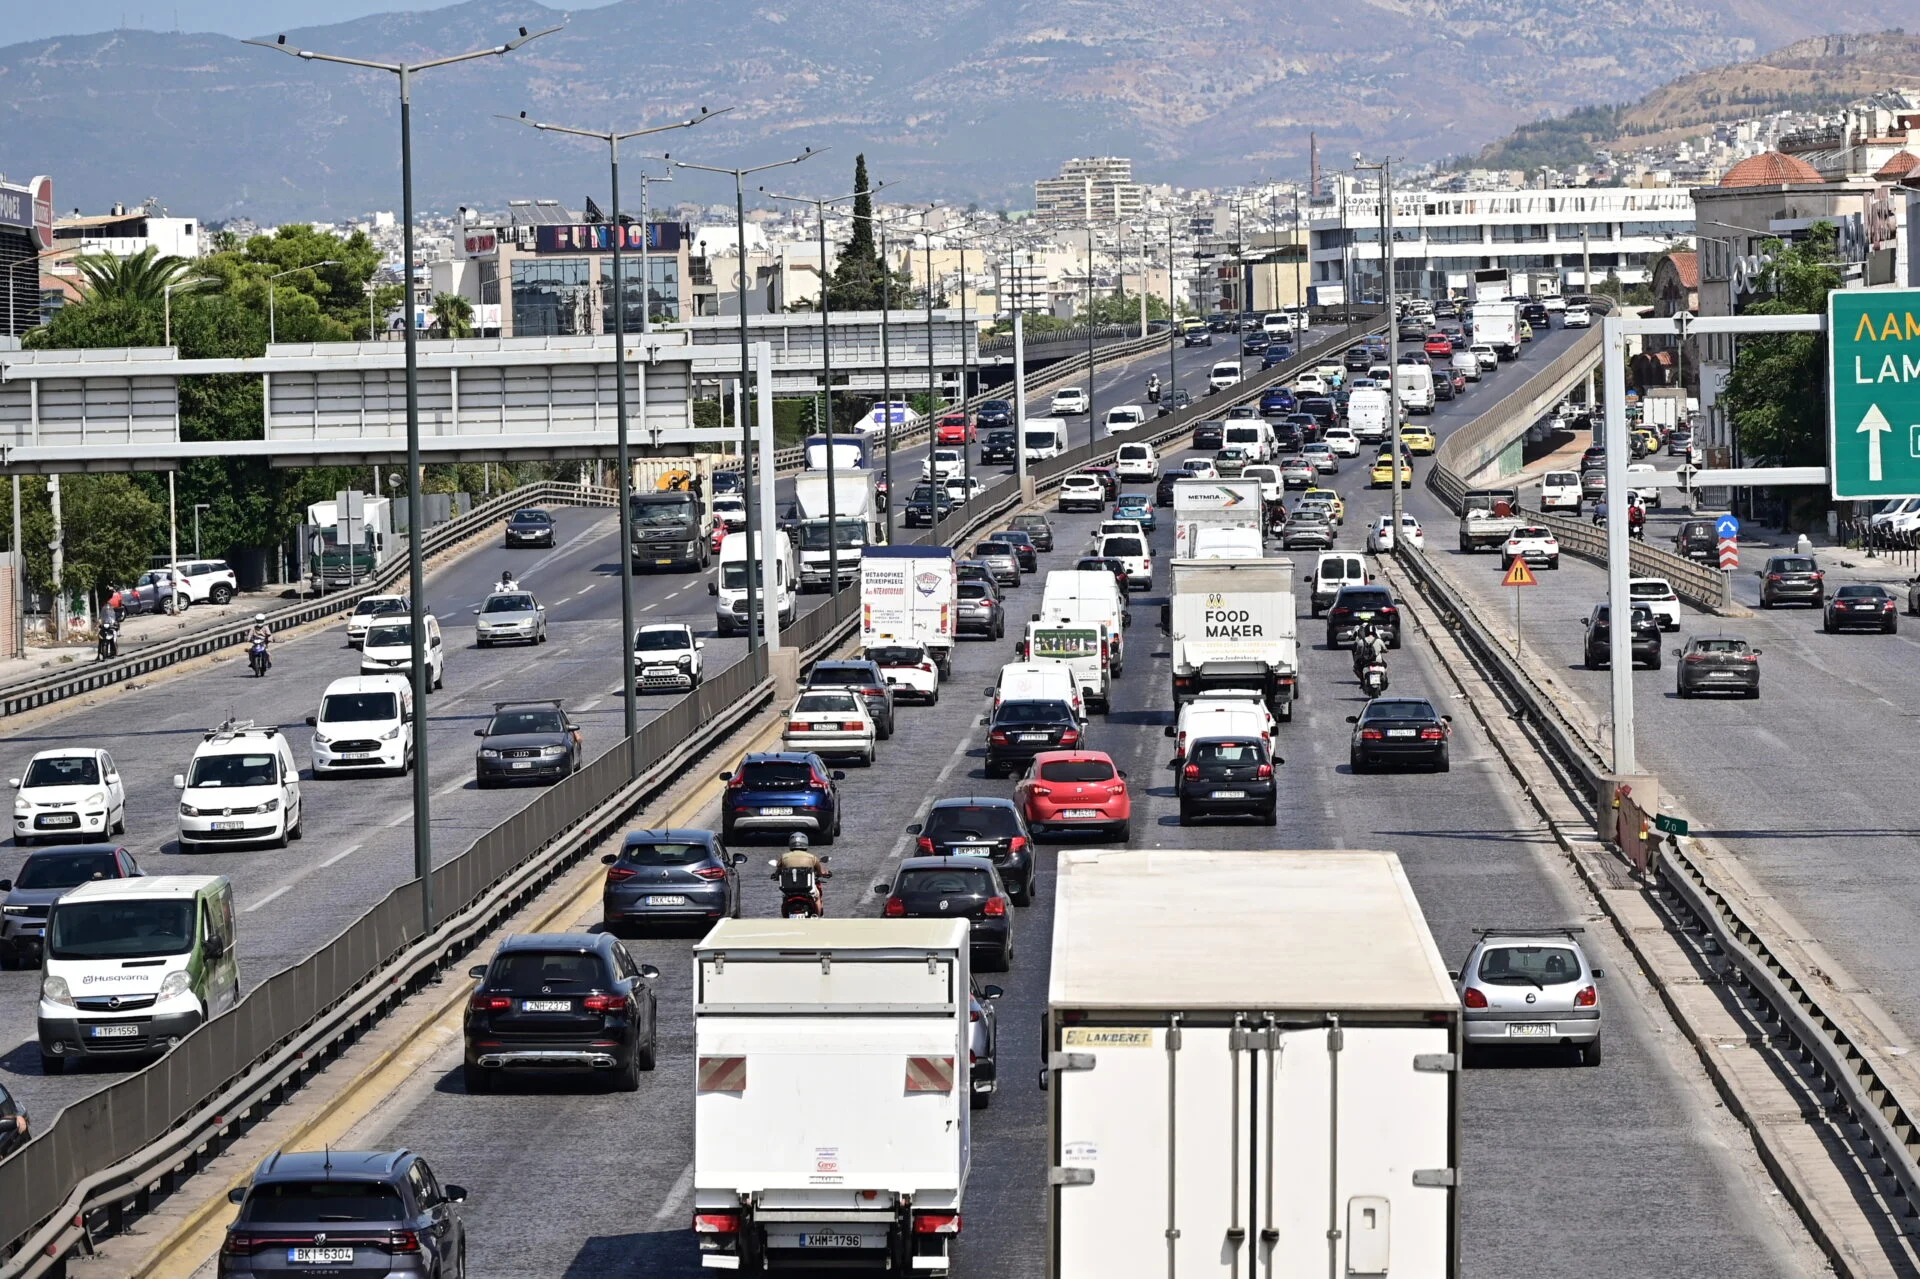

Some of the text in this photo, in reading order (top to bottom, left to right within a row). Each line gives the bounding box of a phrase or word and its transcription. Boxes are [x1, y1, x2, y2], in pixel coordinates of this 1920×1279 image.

[1205, 610, 1249, 622] FOOD
[1205, 625, 1263, 638] MAKER
[529, 1001, 570, 1010] ZNH-2375
[1086, 1033, 1150, 1043] LAMBERET
[808, 1235, 860, 1246] XHM-1796
[297, 1248, 351, 1260] BKI-6304
